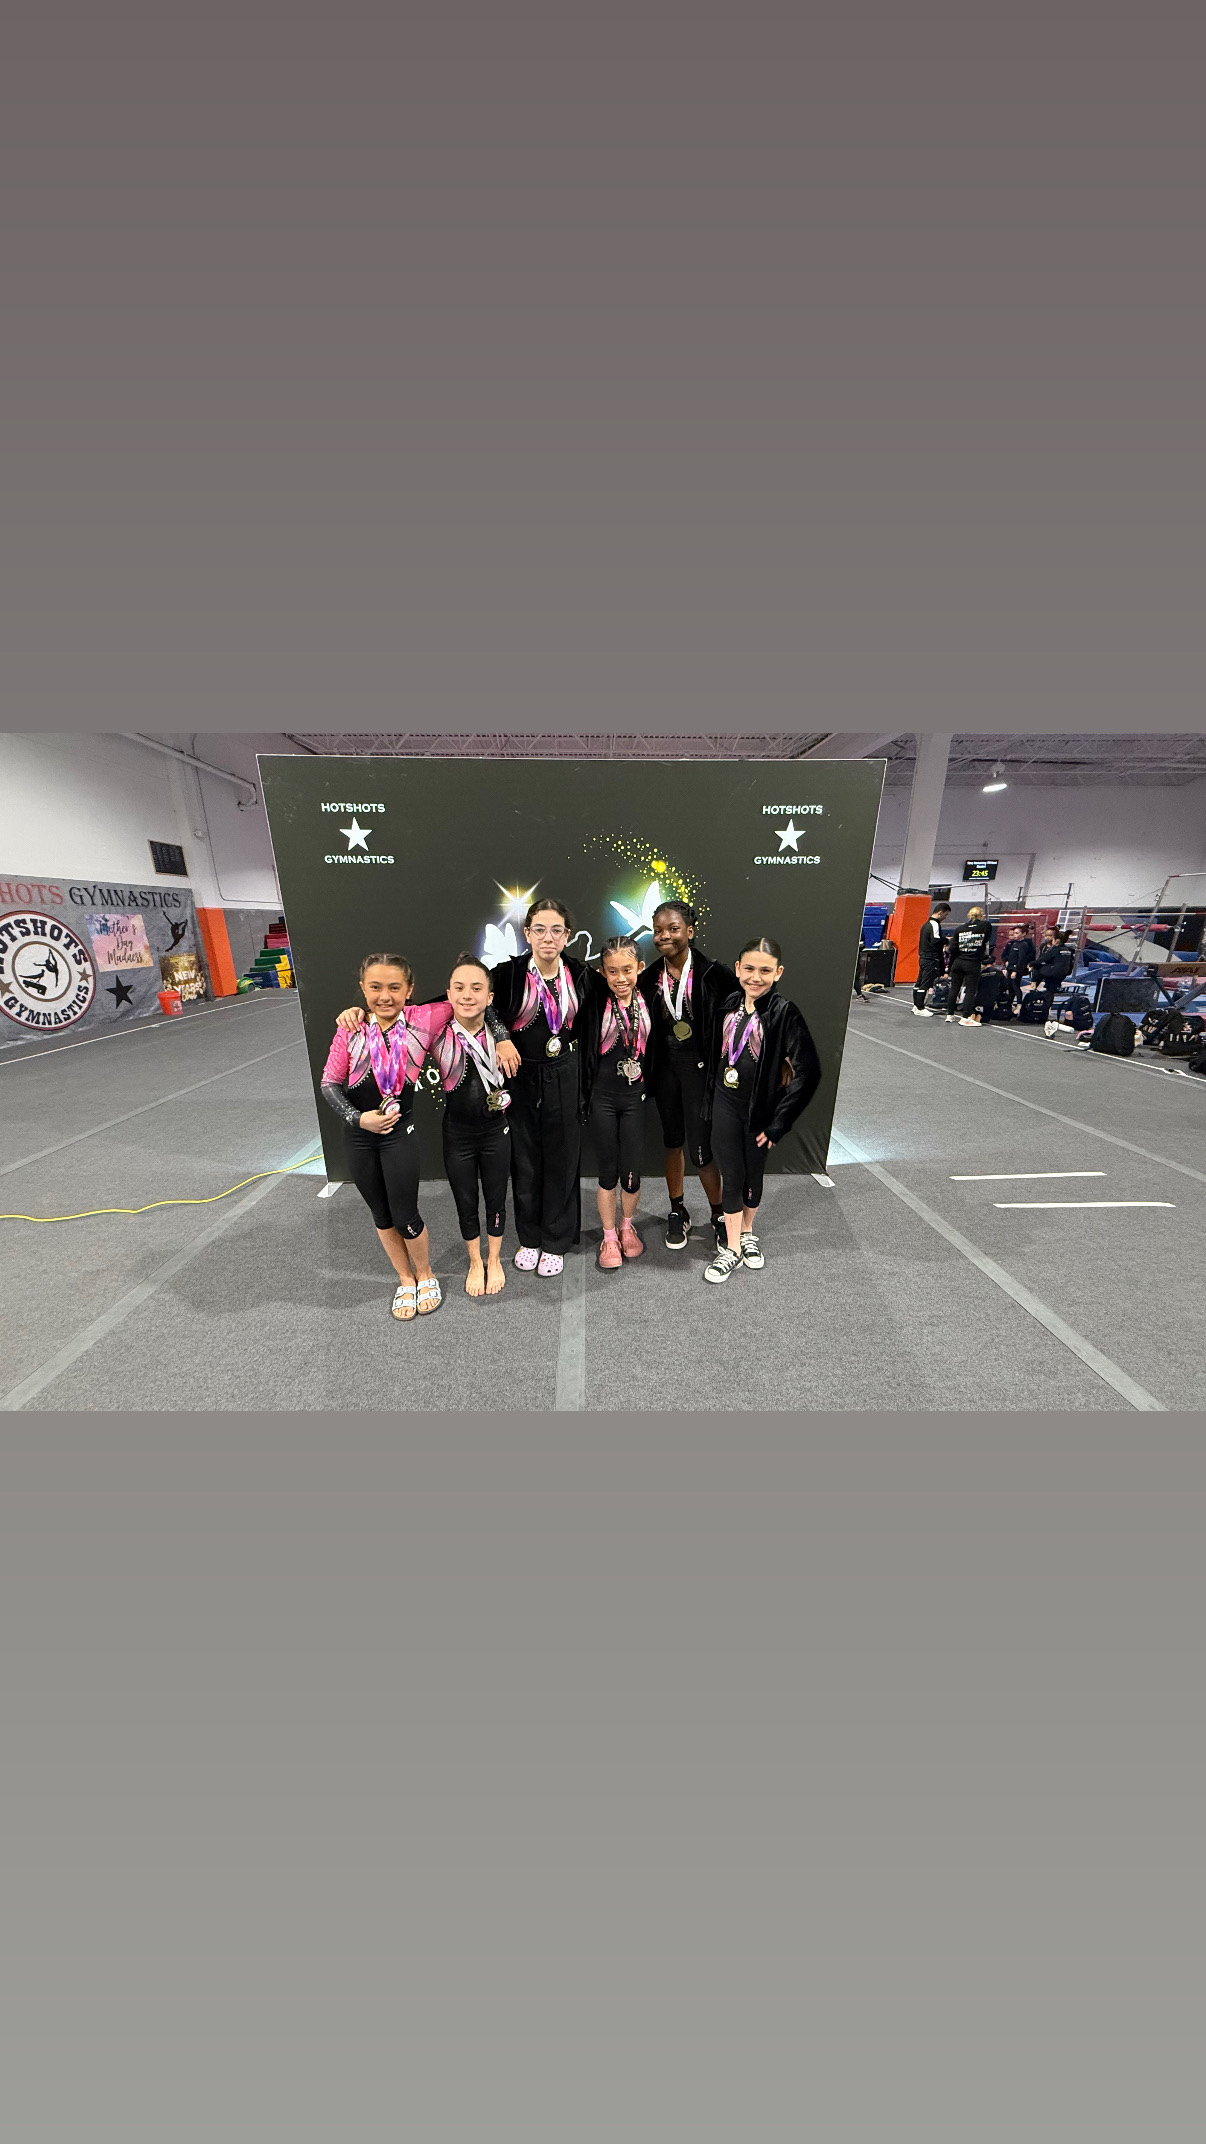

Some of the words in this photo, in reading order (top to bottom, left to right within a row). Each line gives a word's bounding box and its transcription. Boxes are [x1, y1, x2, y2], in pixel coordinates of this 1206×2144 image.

[321, 803, 385, 812] HOTSHOTS
[762, 805, 823, 815] HOTSHOTS
[324, 855, 395, 864] GYMNASTICS
[754, 856, 821, 864] GYMNASTICS
[68, 885, 182, 908] GYMNASTICS
[116, 935, 133, 951] Day
[107, 948, 143, 965] Madness
[173, 970, 195, 982] NEW
[4, 984, 90, 1026] GYMNASTICS
